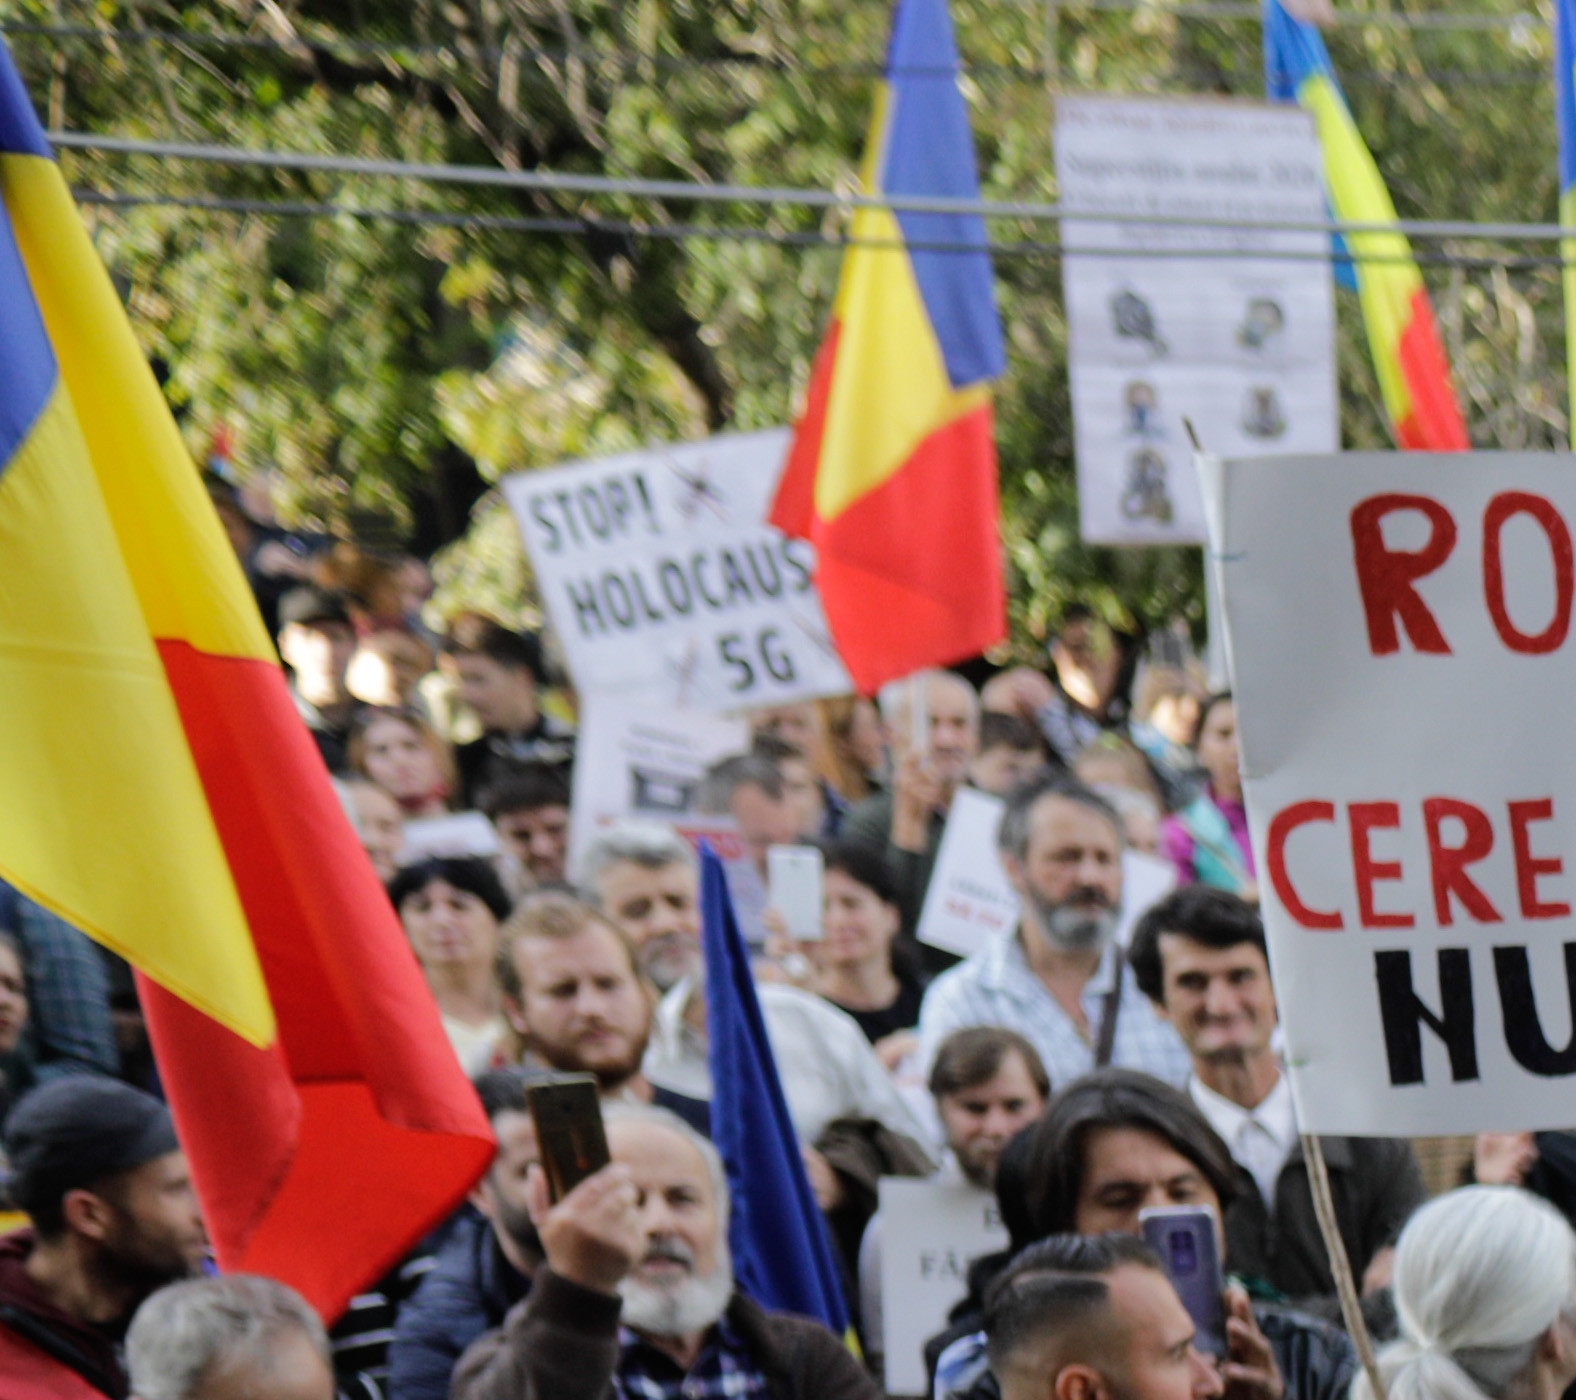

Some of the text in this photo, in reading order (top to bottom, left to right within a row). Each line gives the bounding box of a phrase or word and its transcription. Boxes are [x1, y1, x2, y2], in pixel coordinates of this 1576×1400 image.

[529, 472, 663, 552] STOP!
[566, 539, 814, 638] HOLOCAUS
[716, 630, 795, 691] 5G
